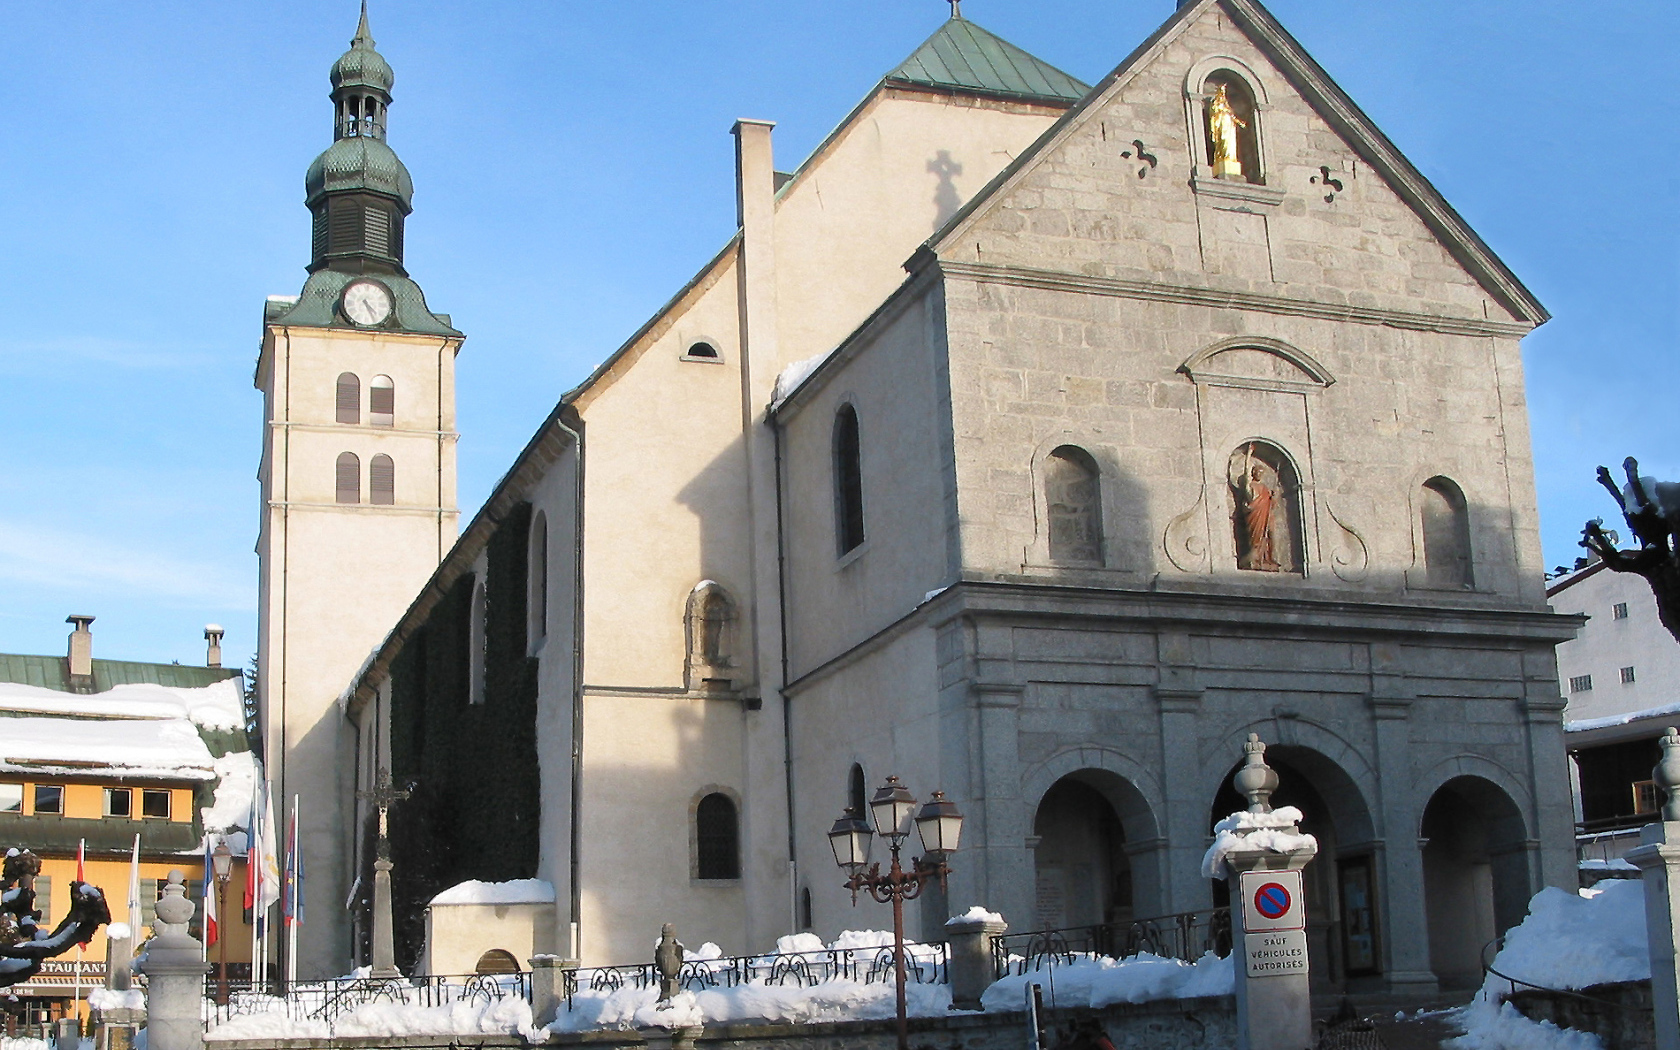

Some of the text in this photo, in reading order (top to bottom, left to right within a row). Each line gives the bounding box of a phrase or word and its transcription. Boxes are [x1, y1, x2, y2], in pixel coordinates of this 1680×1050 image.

[1264, 938, 1287, 946] SAUF
[40, 962, 107, 972] STAURANT
[1253, 960, 1304, 970] AUTORISÉS
